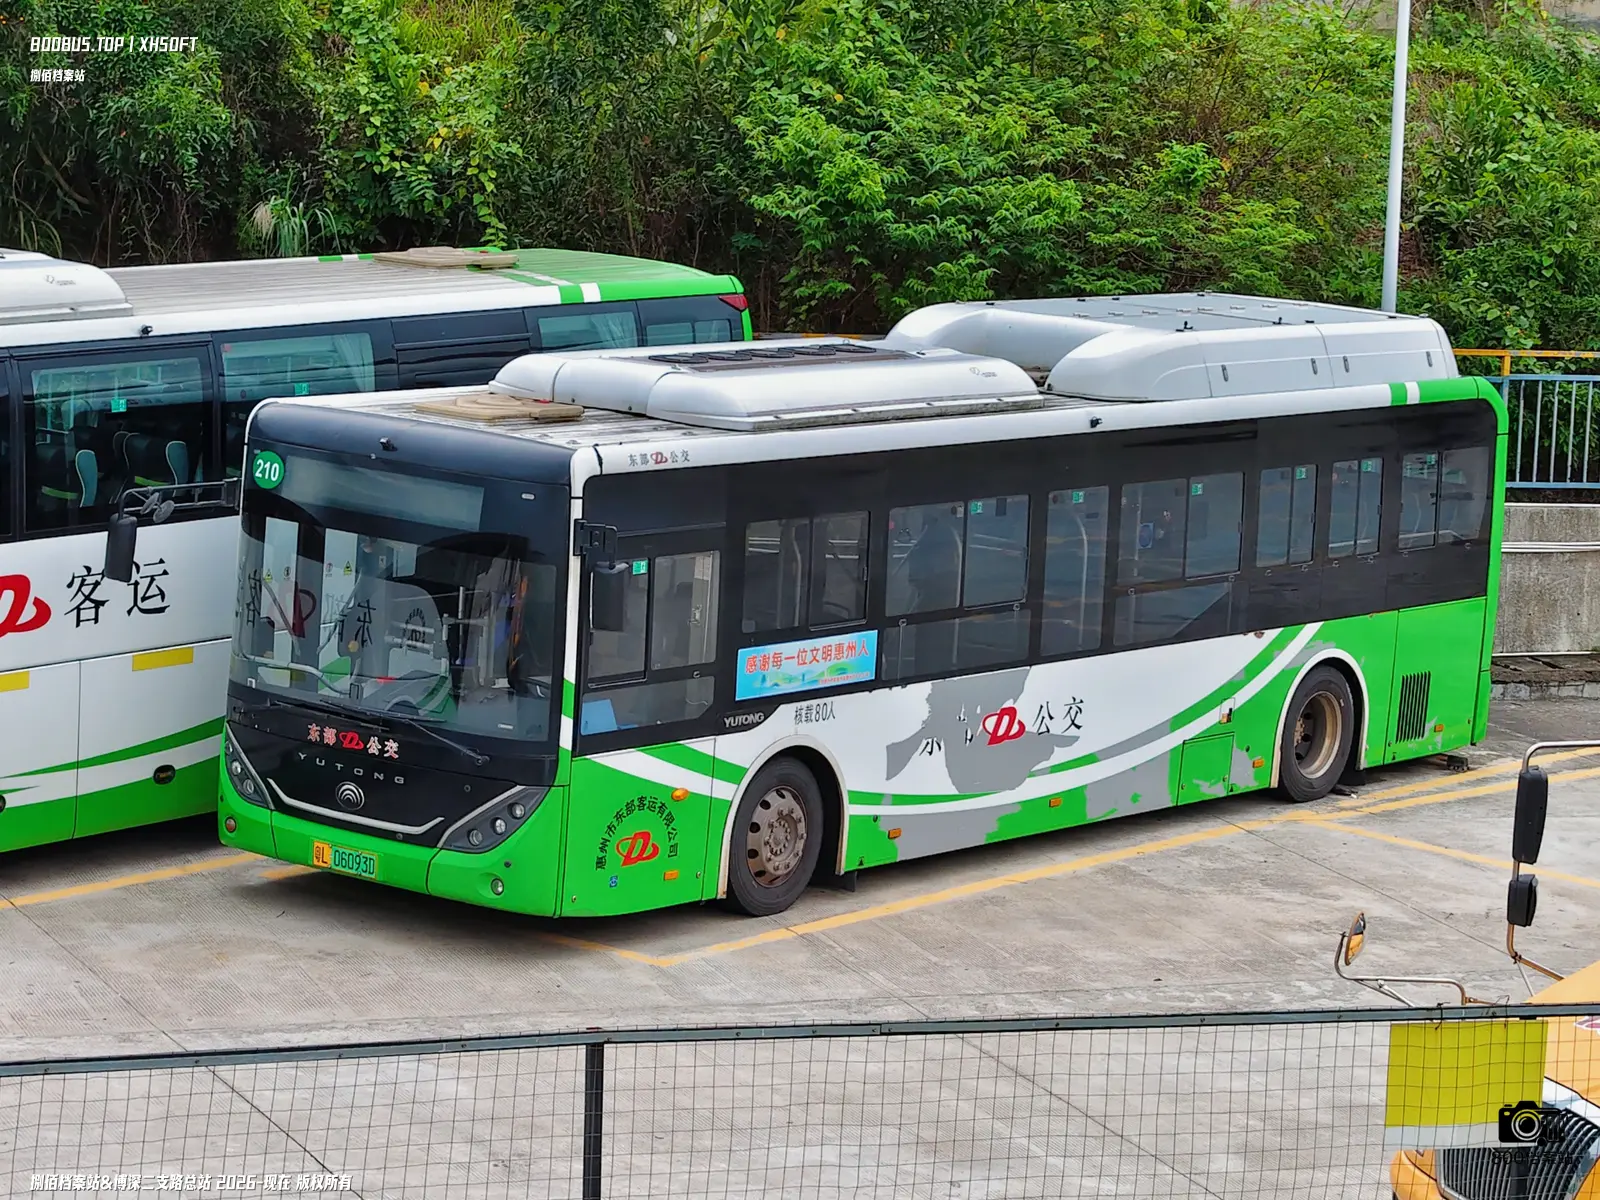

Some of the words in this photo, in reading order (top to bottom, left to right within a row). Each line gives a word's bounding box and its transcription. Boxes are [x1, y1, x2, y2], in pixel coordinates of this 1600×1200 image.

[255, 458, 280, 482] 210
[670, 449, 690, 463] 公交
[64, 558, 170, 628] 客运
[745, 639, 869, 674] 感谢每一位文明惠州人
[724, 712, 765, 728] YUTONG
[794, 701, 836, 725] 核载80人
[1033, 696, 1084, 736] 公交
[307, 723, 337, 746] 东部
[366, 736, 399, 759] 公交
[298, 752, 405, 784] YUTONG
[595, 795, 679, 871] 惠州市东部客运有限公司
